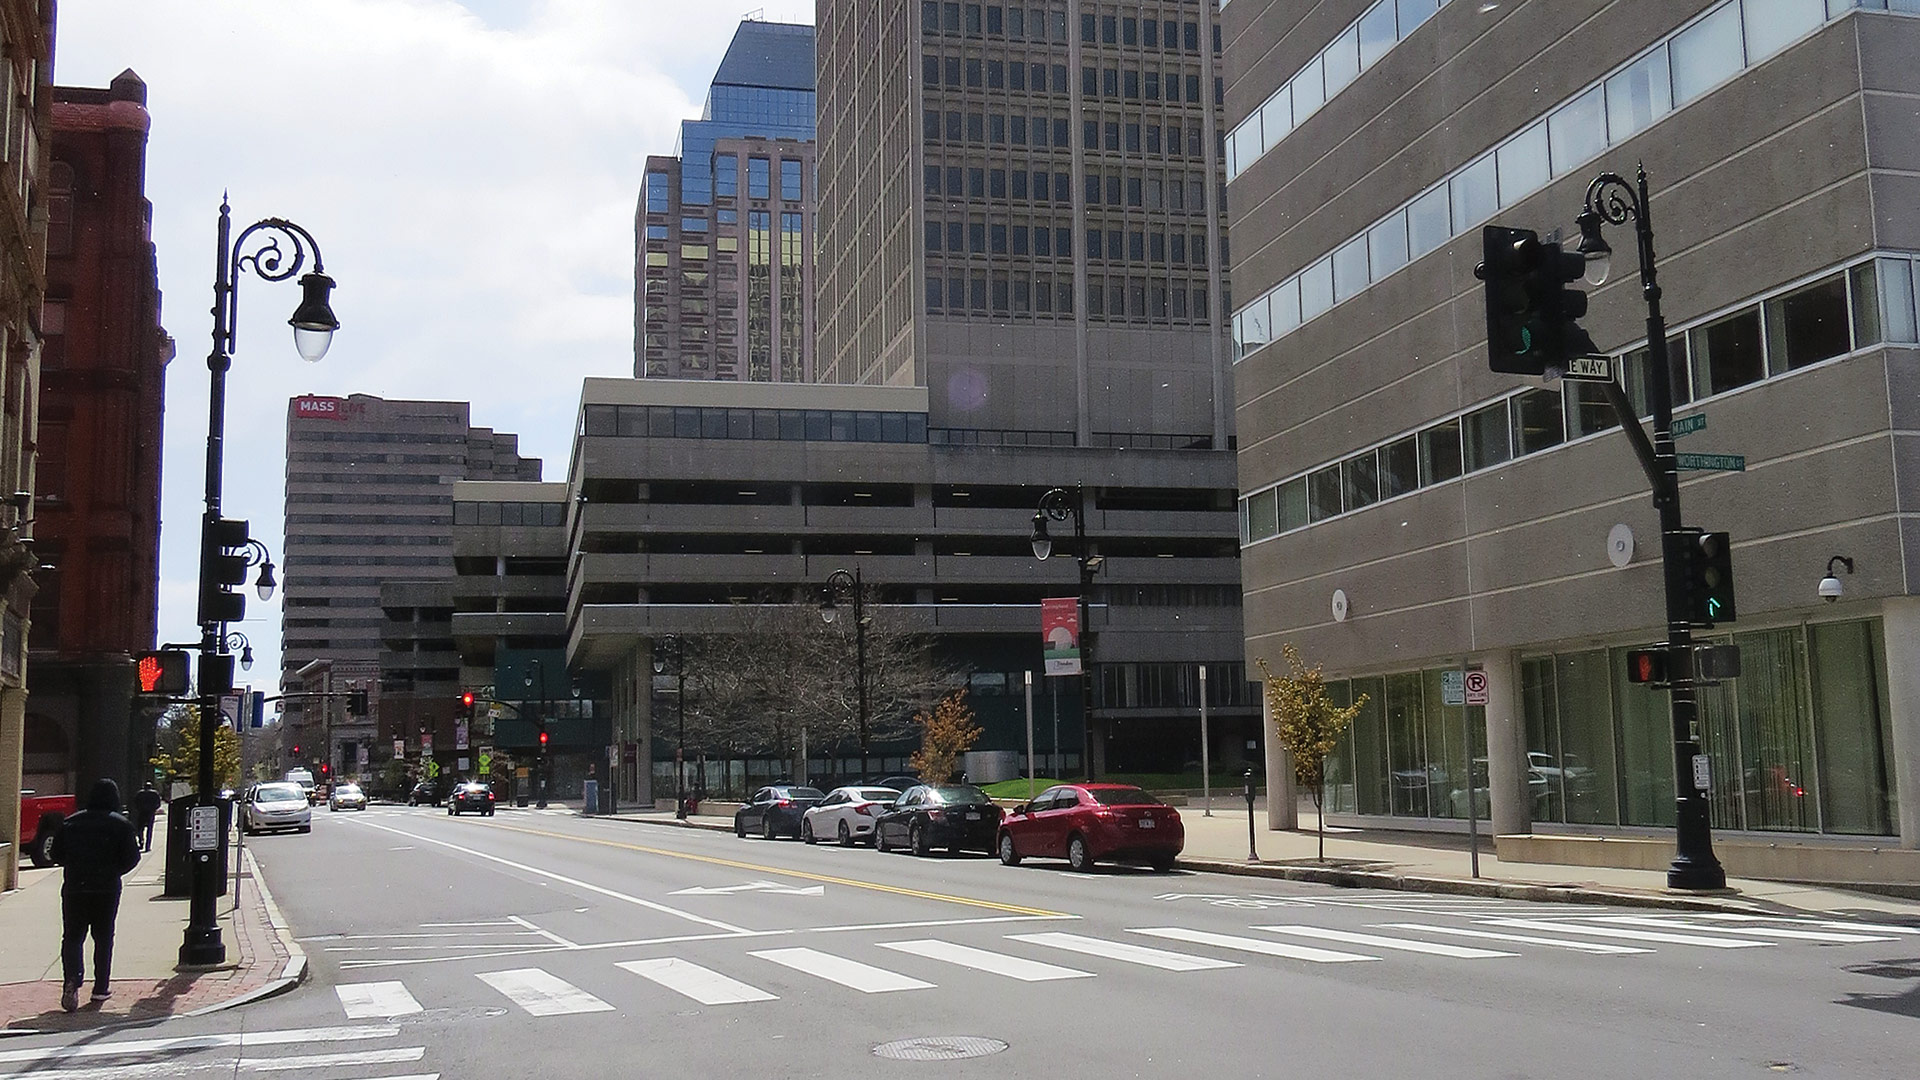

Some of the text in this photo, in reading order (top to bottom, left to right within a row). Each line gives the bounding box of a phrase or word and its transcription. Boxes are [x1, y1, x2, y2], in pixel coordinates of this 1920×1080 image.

[1580, 360, 1603, 374] WAY
[300, 401, 335, 412] MASS
[1672, 418, 1694, 436] MAIN
[1677, 455, 1736, 469] WORTHINGTON
